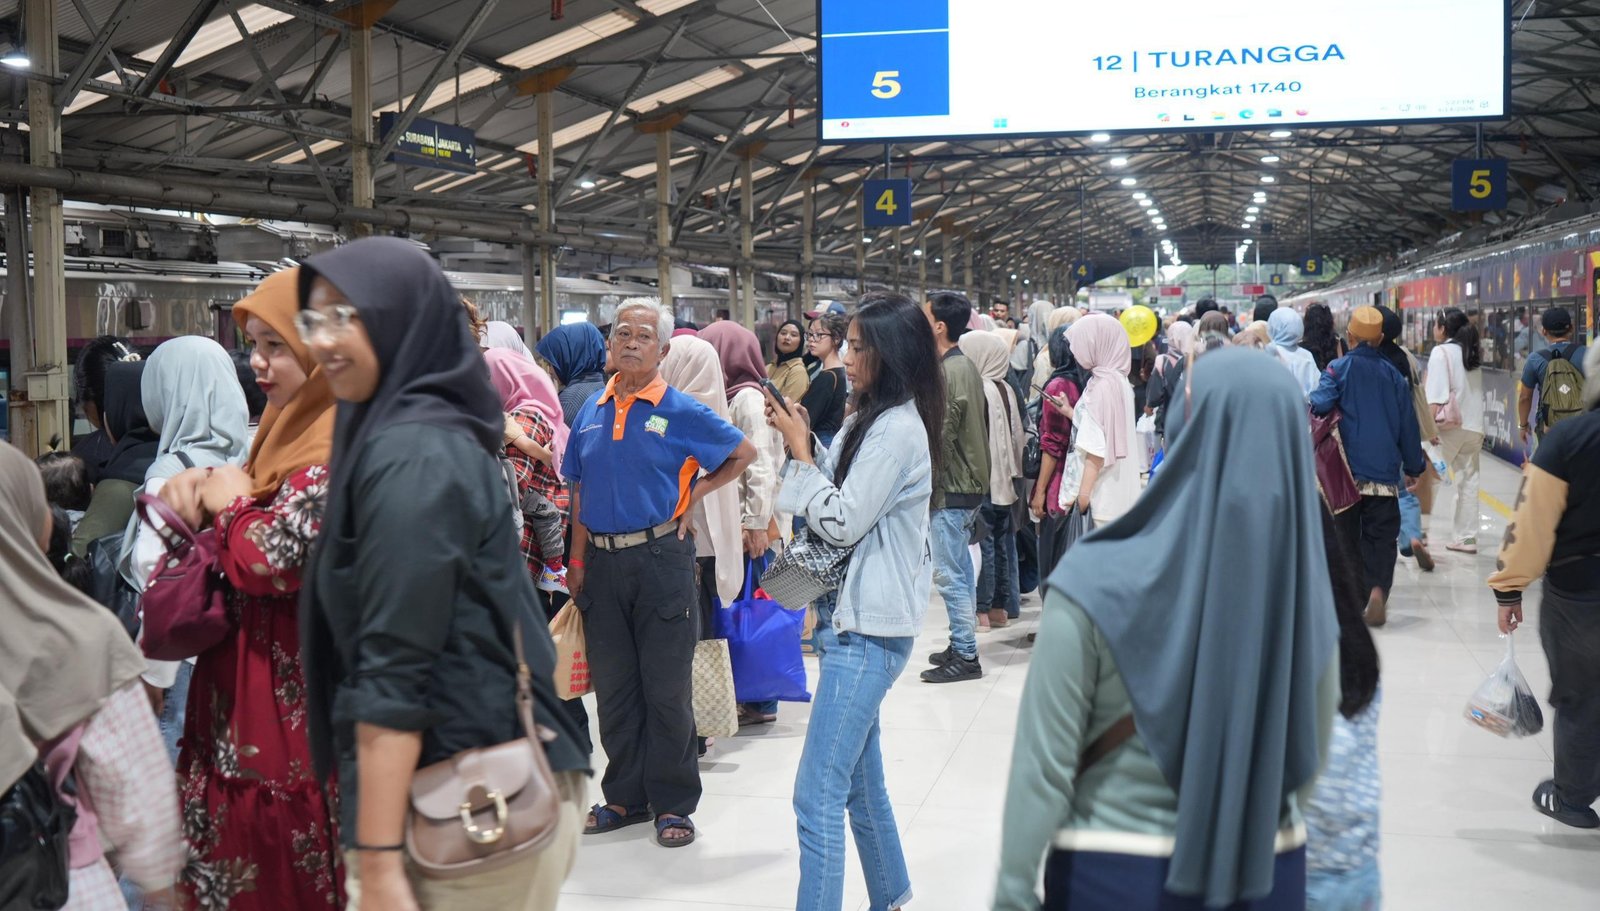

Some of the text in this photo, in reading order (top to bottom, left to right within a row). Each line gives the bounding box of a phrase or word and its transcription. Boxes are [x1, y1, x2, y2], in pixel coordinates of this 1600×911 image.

[1092, 55, 1122, 70] 12
[1148, 44, 1345, 68] TURANGGA
[871, 70, 901, 99] 5
[1134, 81, 1302, 99] Berangkat 17.40
[405, 131, 435, 147] SURABAYA
[438, 138, 462, 153] JAKARTA
[1469, 170, 1491, 198] 5
[875, 189, 897, 215] 4
[1077, 264, 1088, 277] 4
[1306, 259, 1316, 272] 5
